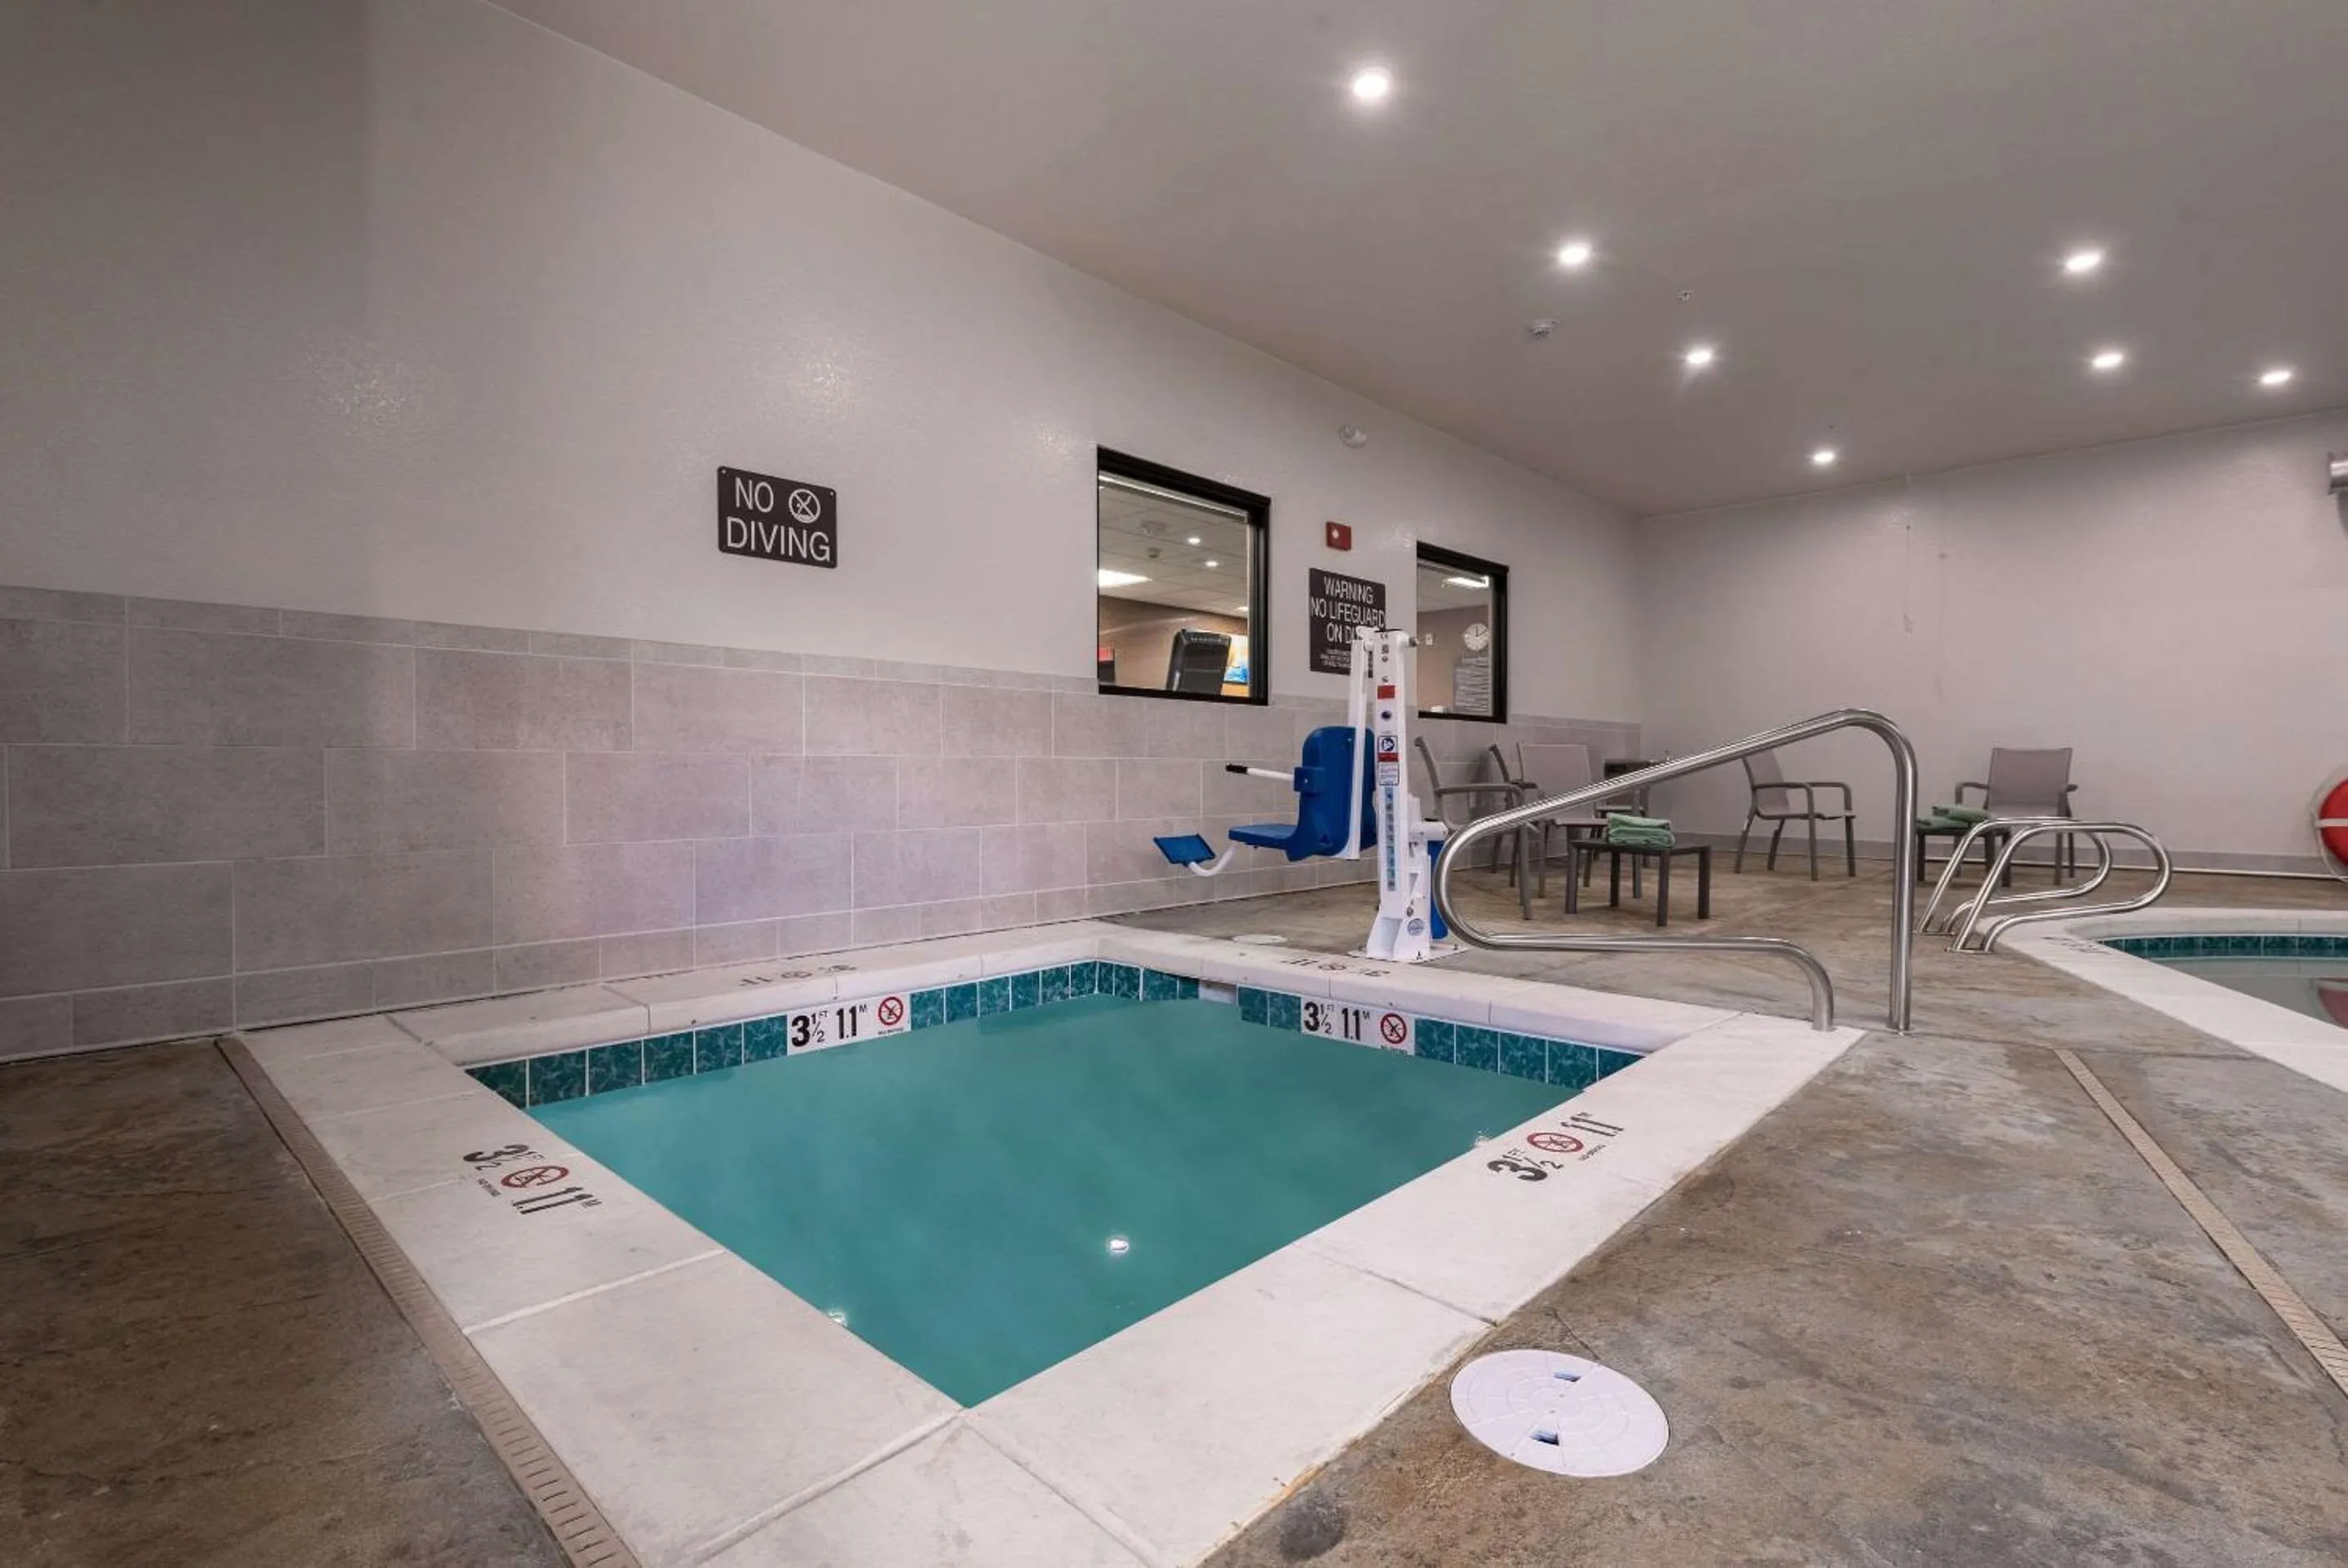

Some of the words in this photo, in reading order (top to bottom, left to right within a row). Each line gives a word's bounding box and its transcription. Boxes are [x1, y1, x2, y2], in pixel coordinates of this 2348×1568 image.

[736, 477, 774, 513] NO
[727, 516, 830, 563] DIVING
[1324, 576, 1373, 605] WARNING
[1311, 597, 1327, 618] NO
[1329, 599, 1386, 628] LIFEGUARD
[1327, 622, 1342, 643] ON
